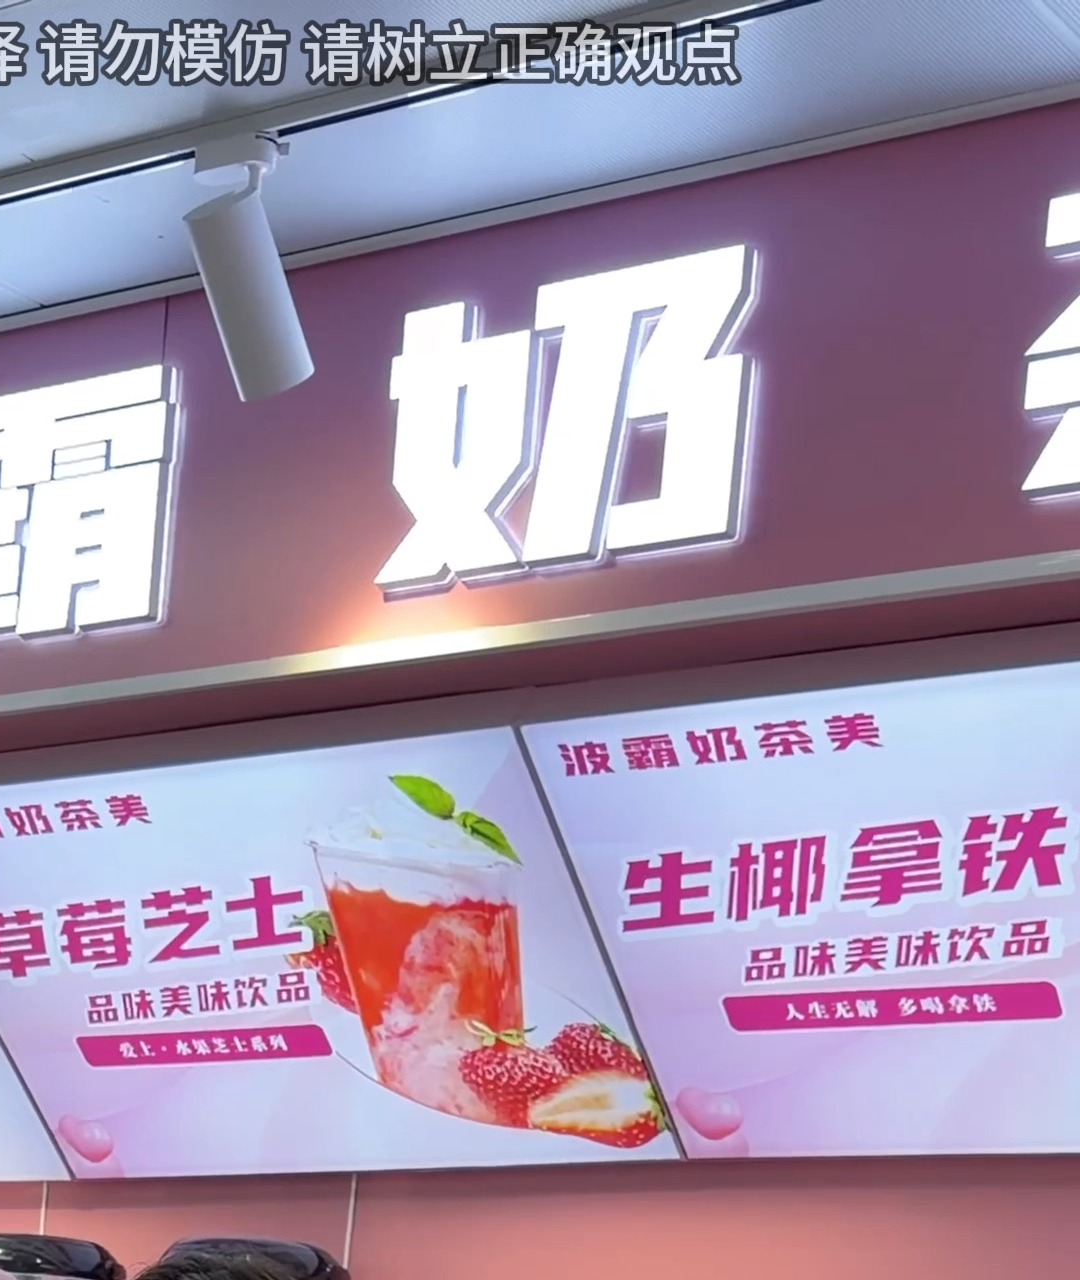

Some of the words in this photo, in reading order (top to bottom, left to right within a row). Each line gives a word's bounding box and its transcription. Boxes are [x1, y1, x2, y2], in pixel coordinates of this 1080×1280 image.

[557, 713, 883, 777] 波霸奶茶美
[622, 806, 1067, 932] 生椰拿铁
[744, 920, 1051, 983] 品味美味饮品
[87, 971, 311, 1024] 品味美味饮品
[786, 999, 878, 1021] 人生无解
[898, 993, 997, 1017] 多喝拿铁
